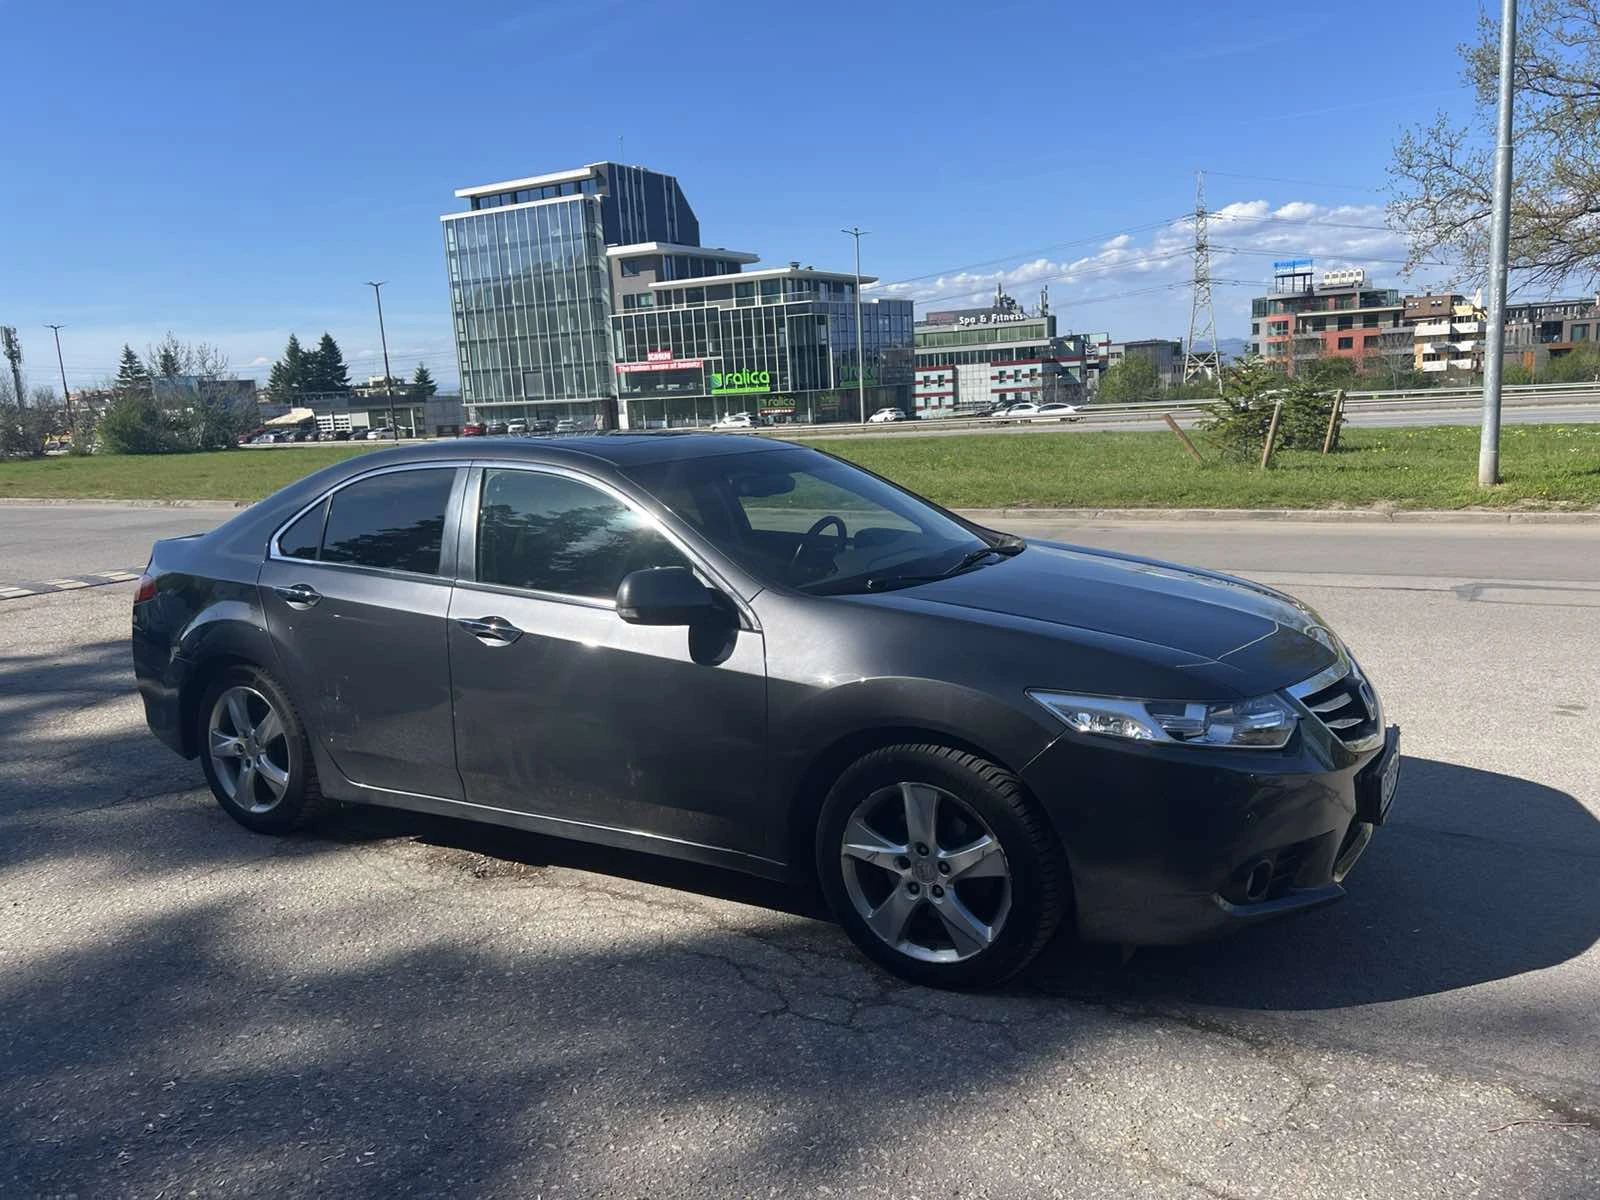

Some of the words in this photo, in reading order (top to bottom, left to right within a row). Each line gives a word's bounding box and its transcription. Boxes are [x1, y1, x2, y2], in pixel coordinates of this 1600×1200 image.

[959, 316, 976, 326] Spa
[980, 314, 987, 323] &
[991, 313, 1024, 323] Fitness
[725, 367, 770, 385] ralica
[768, 396, 796, 406] ralica
